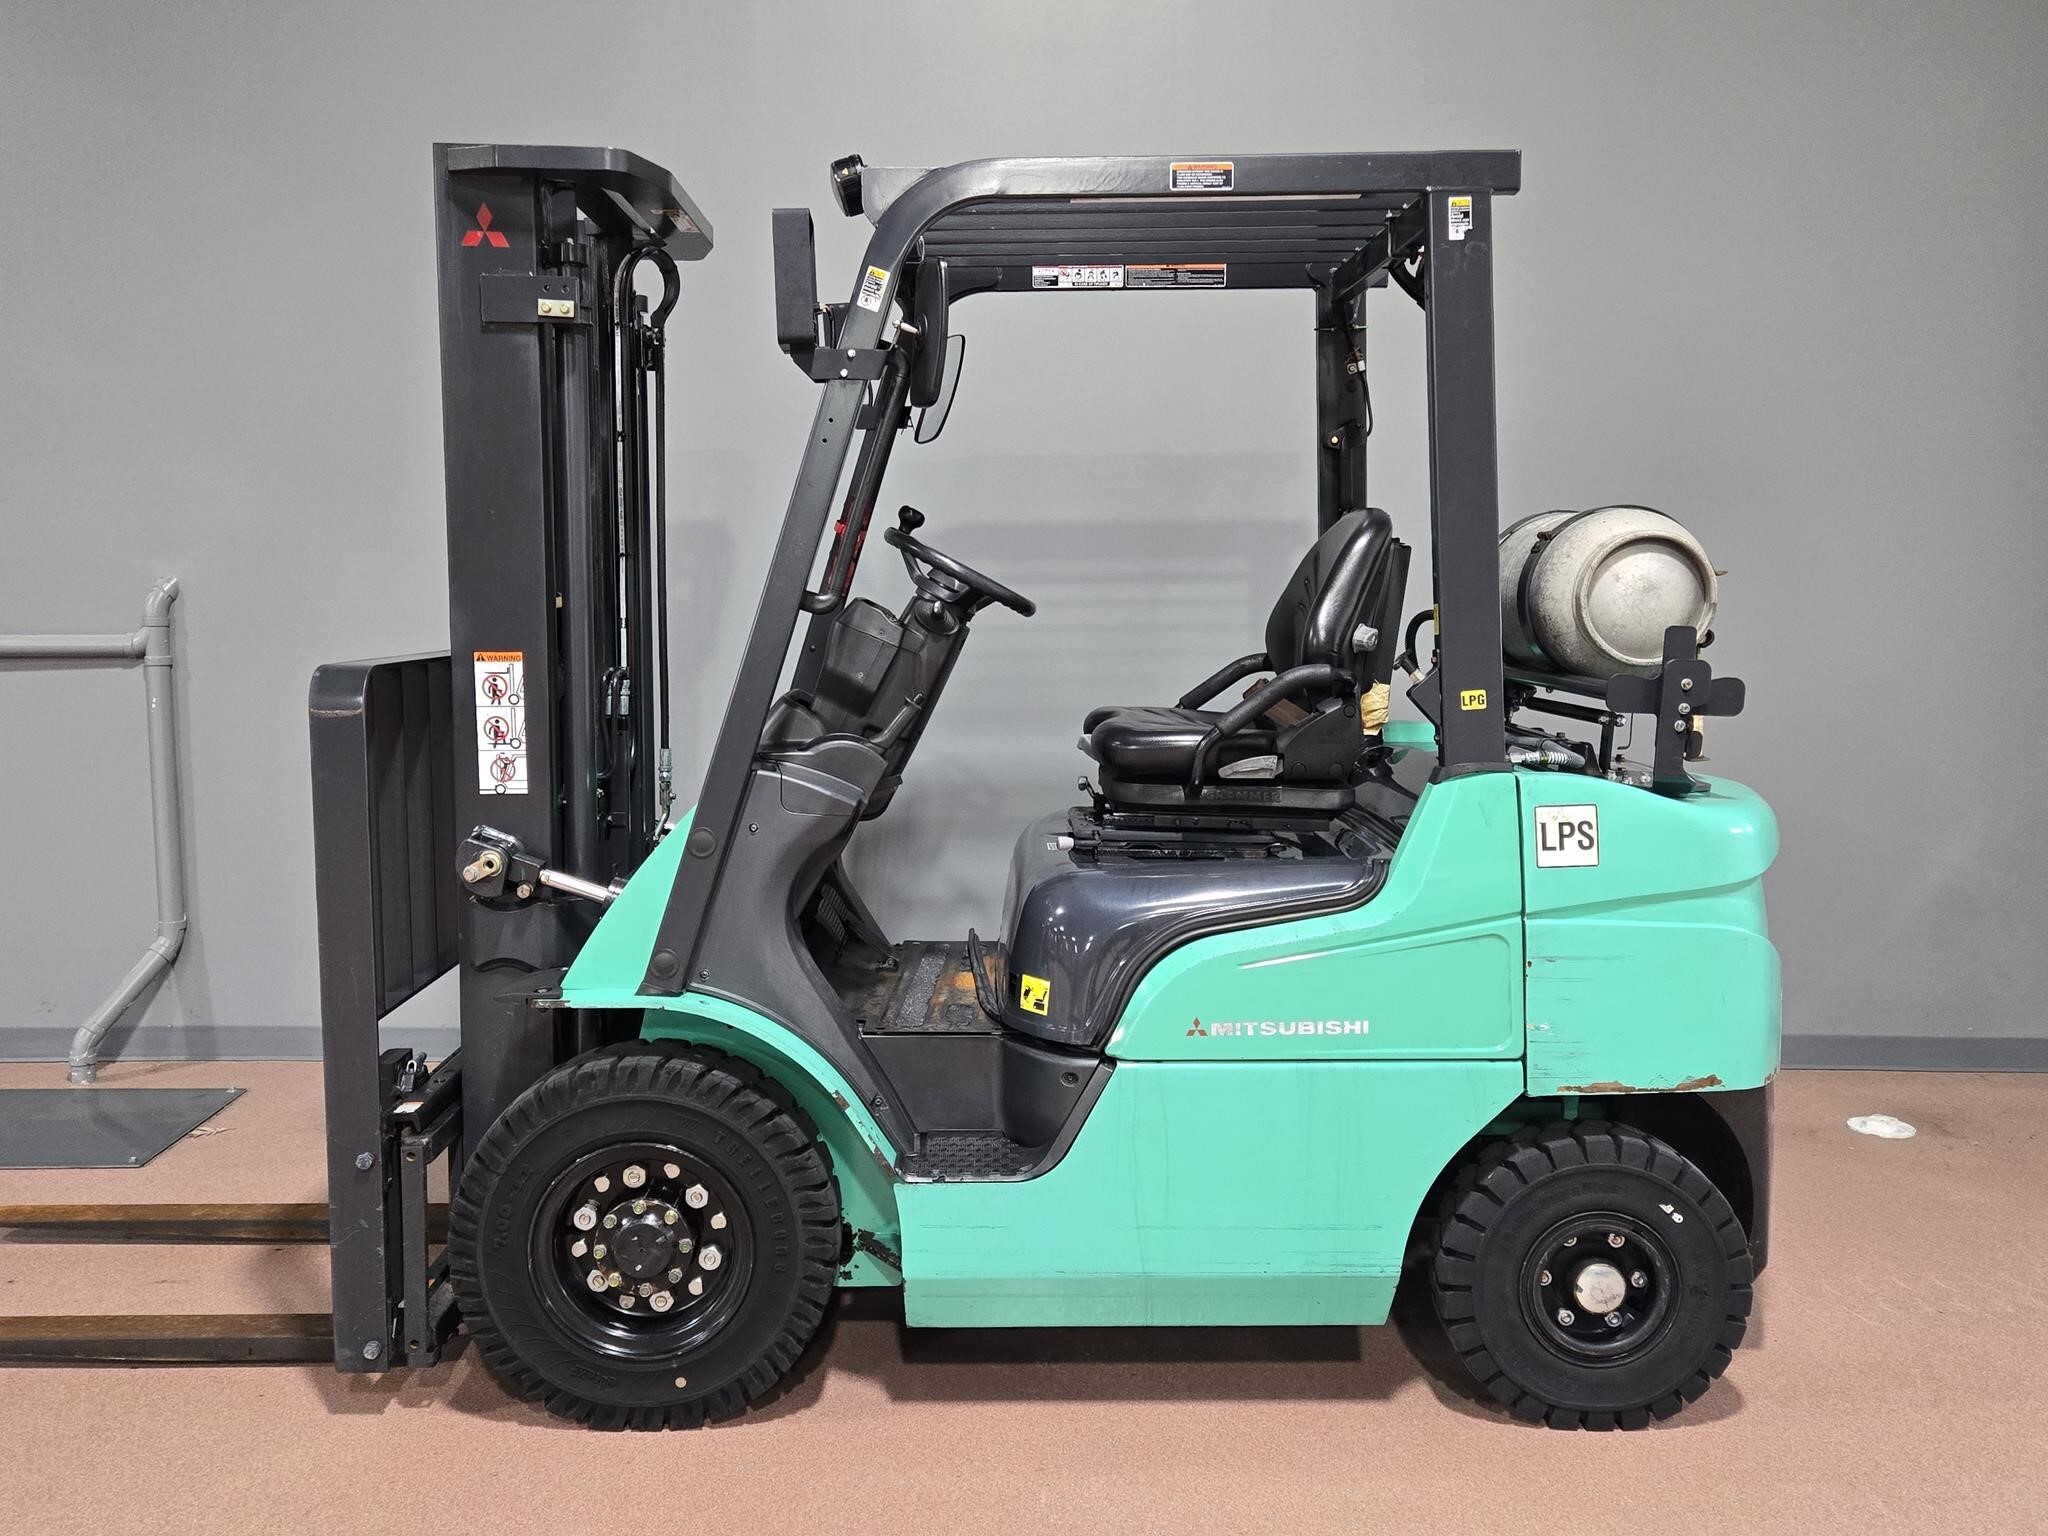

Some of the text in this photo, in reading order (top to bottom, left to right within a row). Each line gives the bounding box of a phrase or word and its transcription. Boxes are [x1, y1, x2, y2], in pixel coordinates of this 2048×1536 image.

[1462, 693, 1485, 707] LPG
[1539, 820, 1595, 851] LPS
[1210, 1020, 1369, 1037] MITSUBISHI
